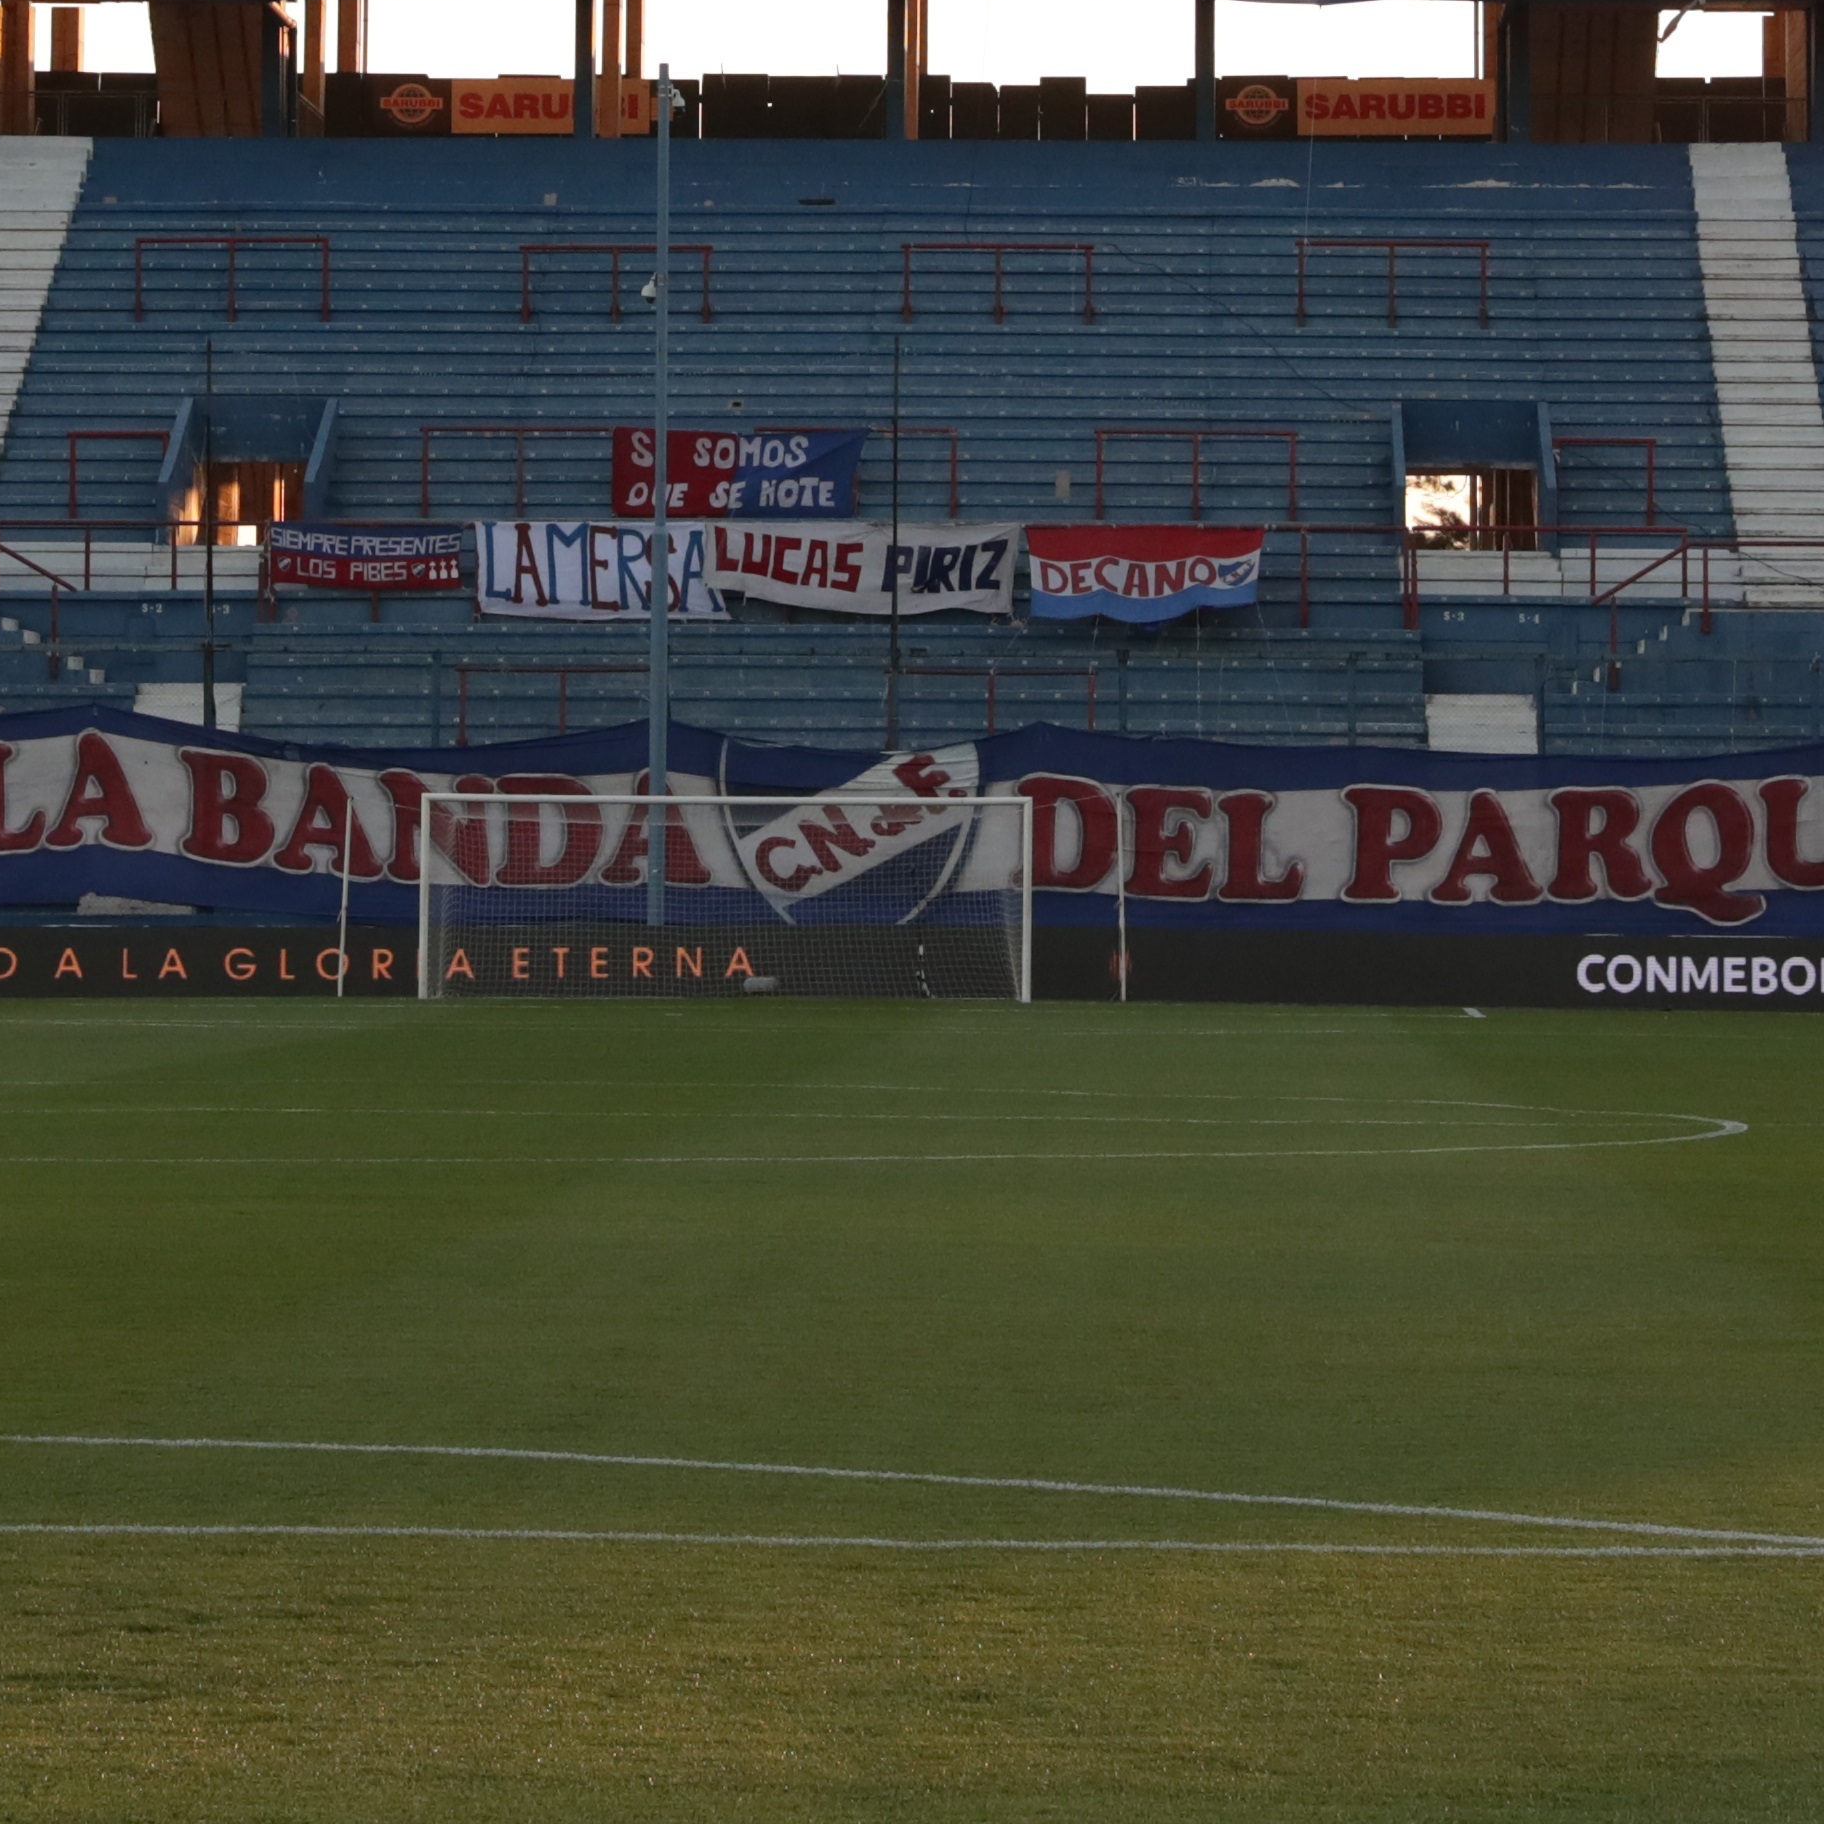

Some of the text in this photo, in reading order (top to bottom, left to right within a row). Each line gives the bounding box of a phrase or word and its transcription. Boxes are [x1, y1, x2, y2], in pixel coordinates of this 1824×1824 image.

[1305, 93, 1486, 120] SARUBBI
[693, 434, 809, 470] SOMOS
[709, 480, 743, 509] SE
[759, 477, 836, 509] NOTE
[297, 558, 408, 582] LOS PIBES
[714, 526, 1009, 594] LUCAS PIRIZ
[1040, 556, 1218, 597] DECANO
[179, 744, 713, 889] BANDA
[1014, 772, 1305, 903] DEL
[53, 947, 83, 979] A
[122, 947, 188, 979] LA
[512, 945, 755, 979] ETERNA
